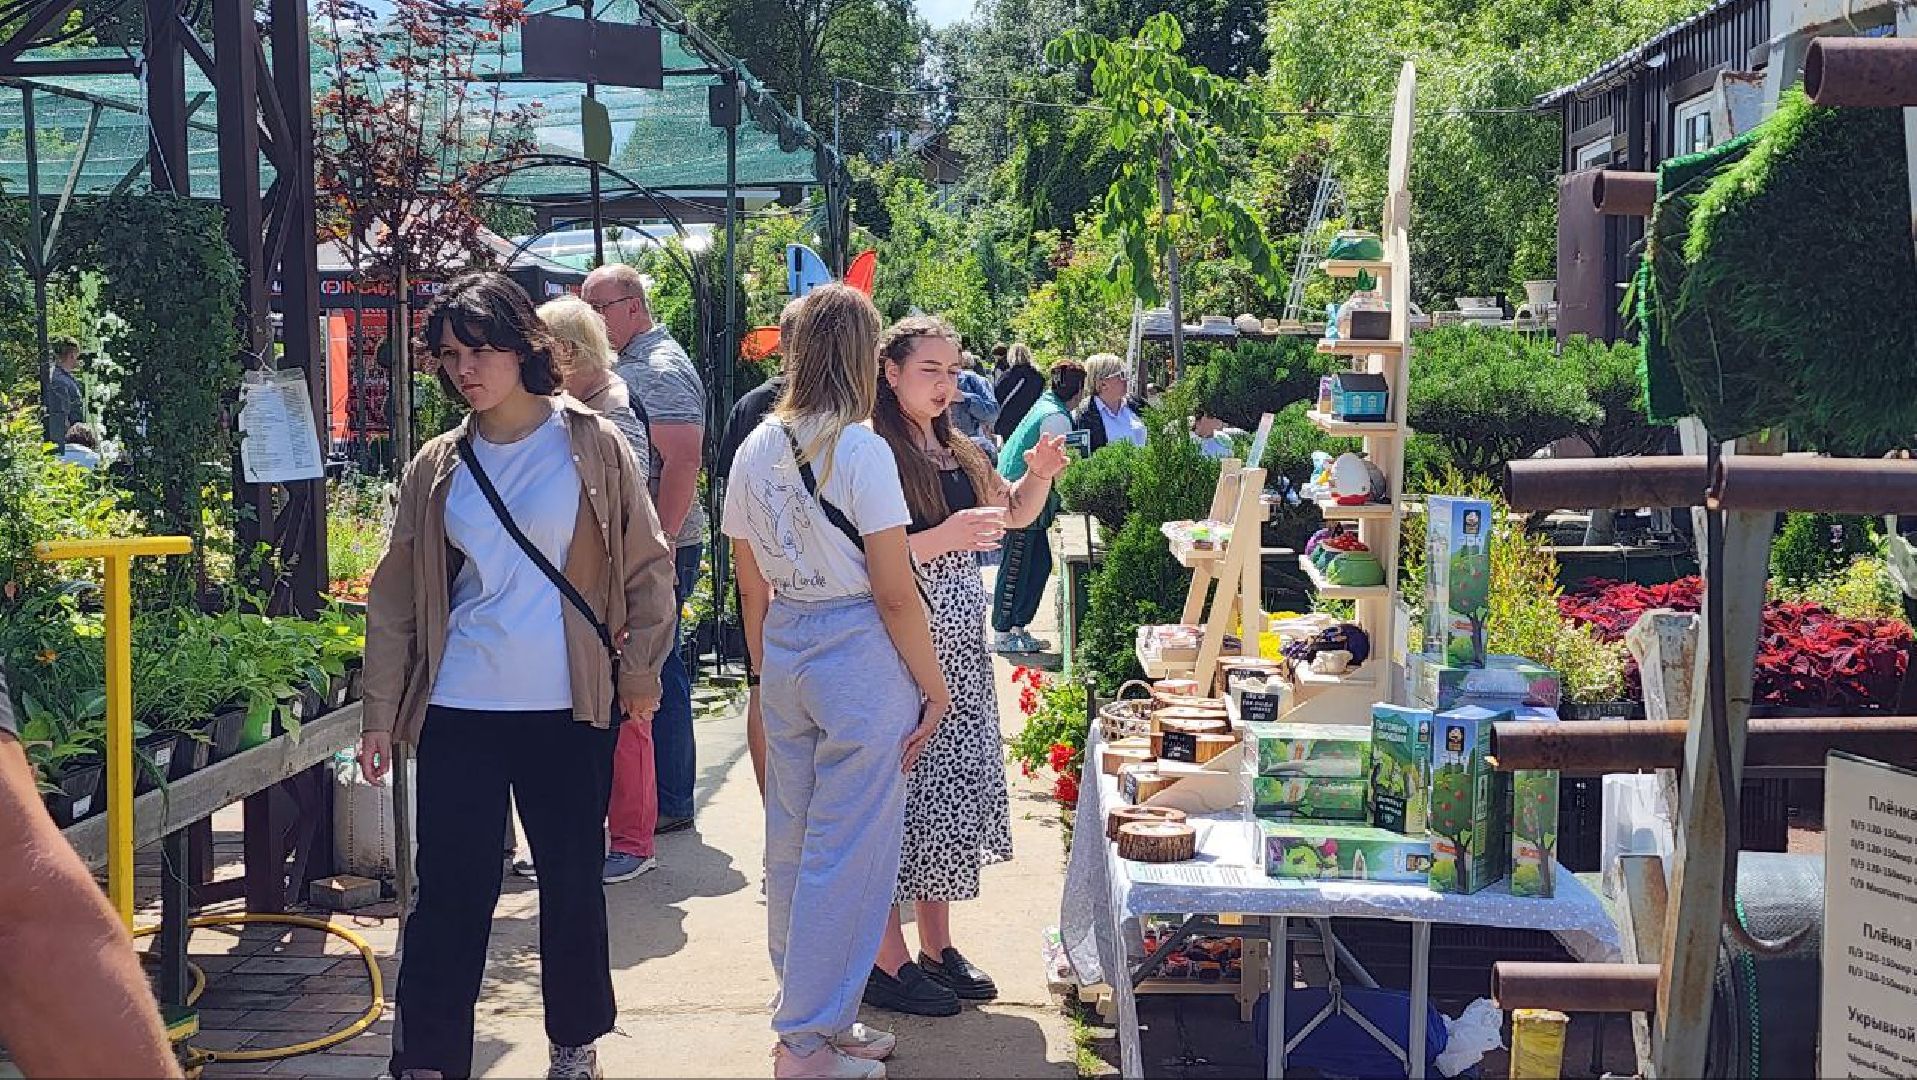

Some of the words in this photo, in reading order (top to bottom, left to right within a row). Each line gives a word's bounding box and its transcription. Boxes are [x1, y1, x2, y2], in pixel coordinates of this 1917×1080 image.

[1868, 795, 1917, 821] Плёнка
[1863, 921, 1913, 952] Плёнка
[1848, 1005, 1916, 1042] Укрывной
